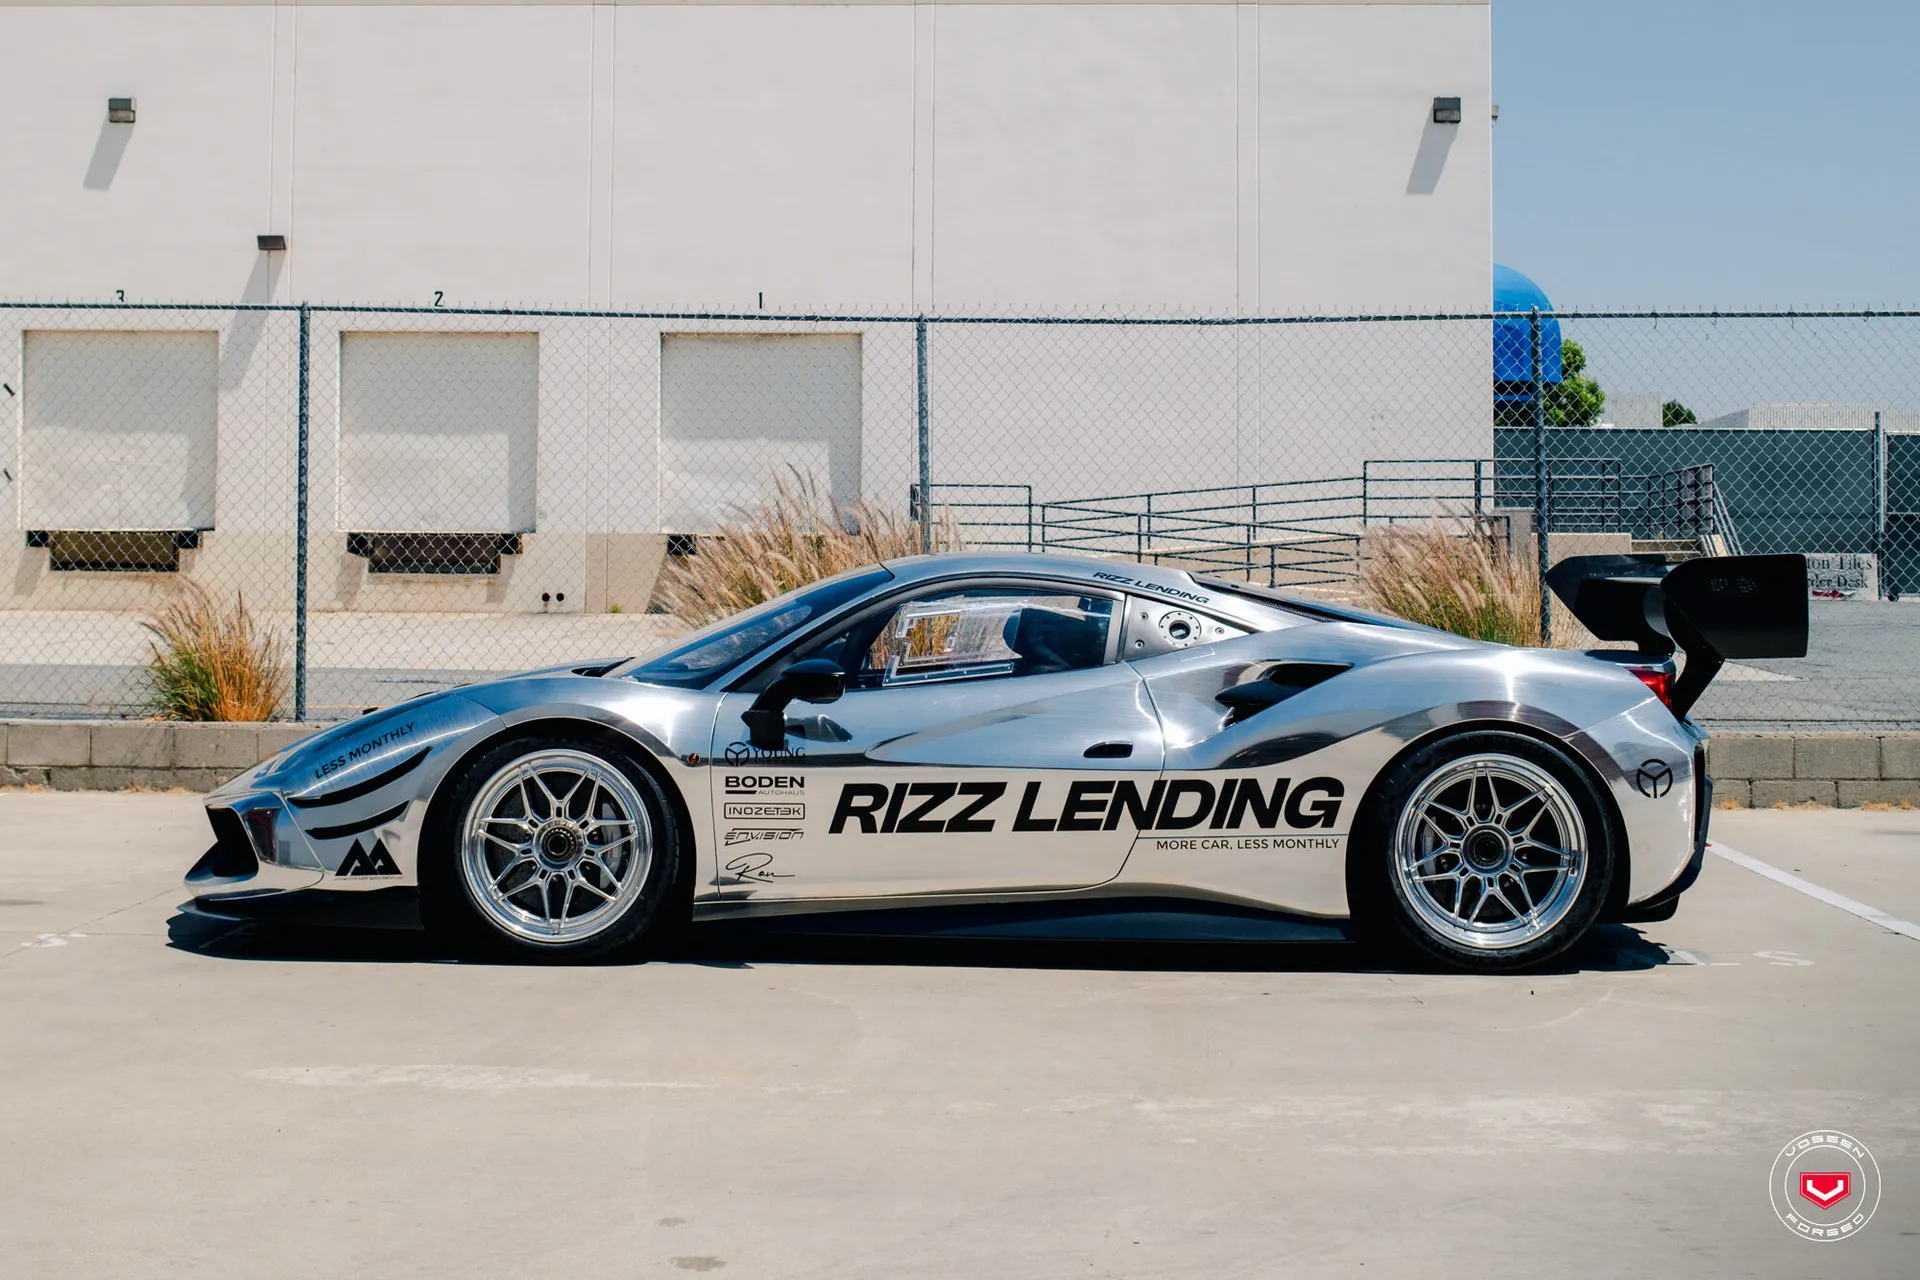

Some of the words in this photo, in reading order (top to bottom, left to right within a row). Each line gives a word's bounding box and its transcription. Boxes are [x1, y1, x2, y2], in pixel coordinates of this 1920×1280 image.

[434, 291, 443, 307] 2
[1093, 572, 1134, 584] RIZZ
[1134, 581, 1209, 604] LENDING
[315, 756, 346, 779] LESS
[349, 722, 414, 761] MONTHLY
[725, 776, 805, 788] BODEN
[828, 780, 1008, 834] RIZZ
[1011, 776, 1346, 832] LENDING
[1156, 839, 1197, 850] MORE
[1201, 839, 1233, 851] CAR,
[1237, 838, 1269, 849] LESS
[1273, 838, 1340, 850] MONTHLY
